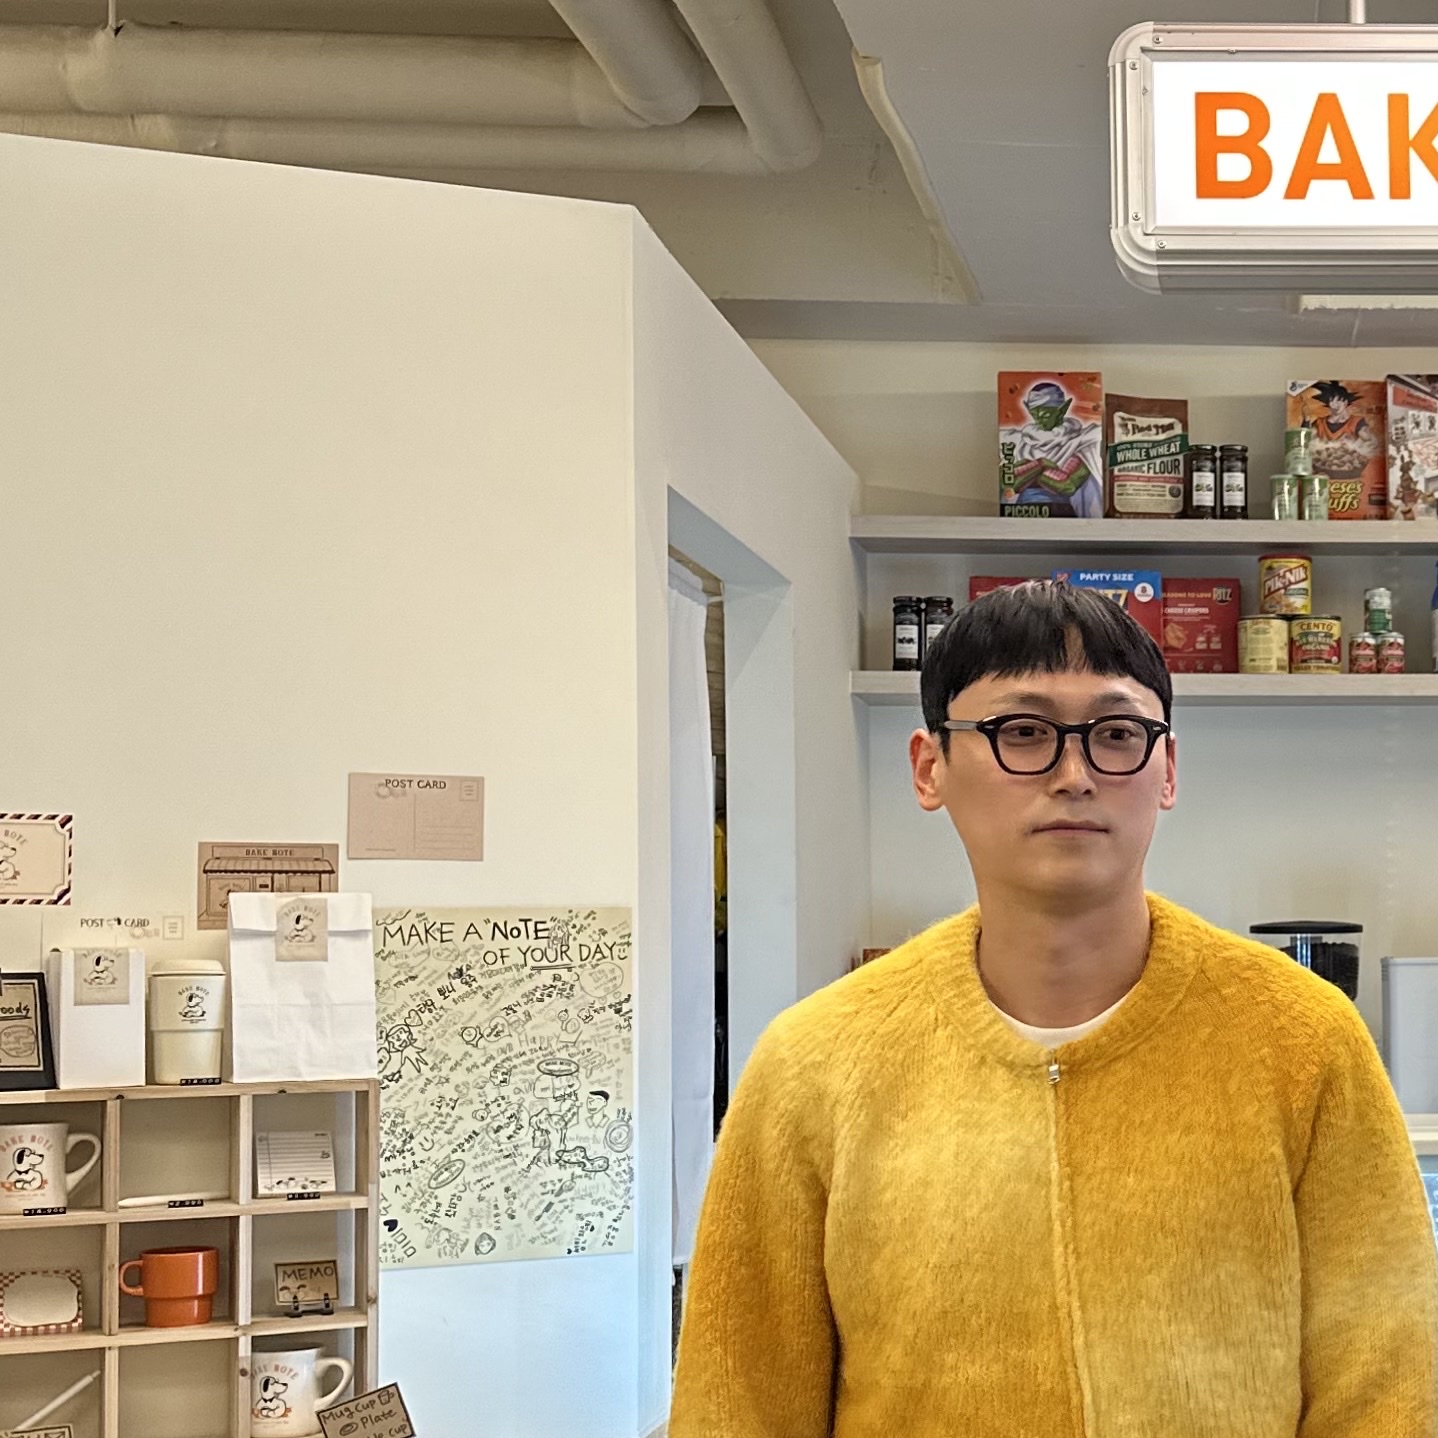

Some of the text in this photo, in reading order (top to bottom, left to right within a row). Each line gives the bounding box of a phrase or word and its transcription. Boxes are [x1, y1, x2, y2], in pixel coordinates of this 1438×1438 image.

[1117, 441, 1181, 462] WHOLE WHEAT
[1147, 459, 1181, 474] FLOUR
[1329, 494, 1360, 511] uffs
[1005, 505, 1050, 517] PICCOLO
[1080, 573, 1134, 581] PARTY SIZE
[1213, 588, 1232, 600] RITZ
[1300, 622, 1333, 631] CENTO
[385, 778, 447, 790] POST CARD
[80, 918, 150, 927] POST CARD
[383, 922, 455, 947] MAKE
[463, 922, 483, 942] A
[483, 942, 618, 966] OF YOUR DAY
[281, 1265, 335, 1280] MEMO
[274, 1364, 299, 1379] NOTE
[322, 1408, 355, 1425] Mug
[361, 1409, 397, 1428] Plate
